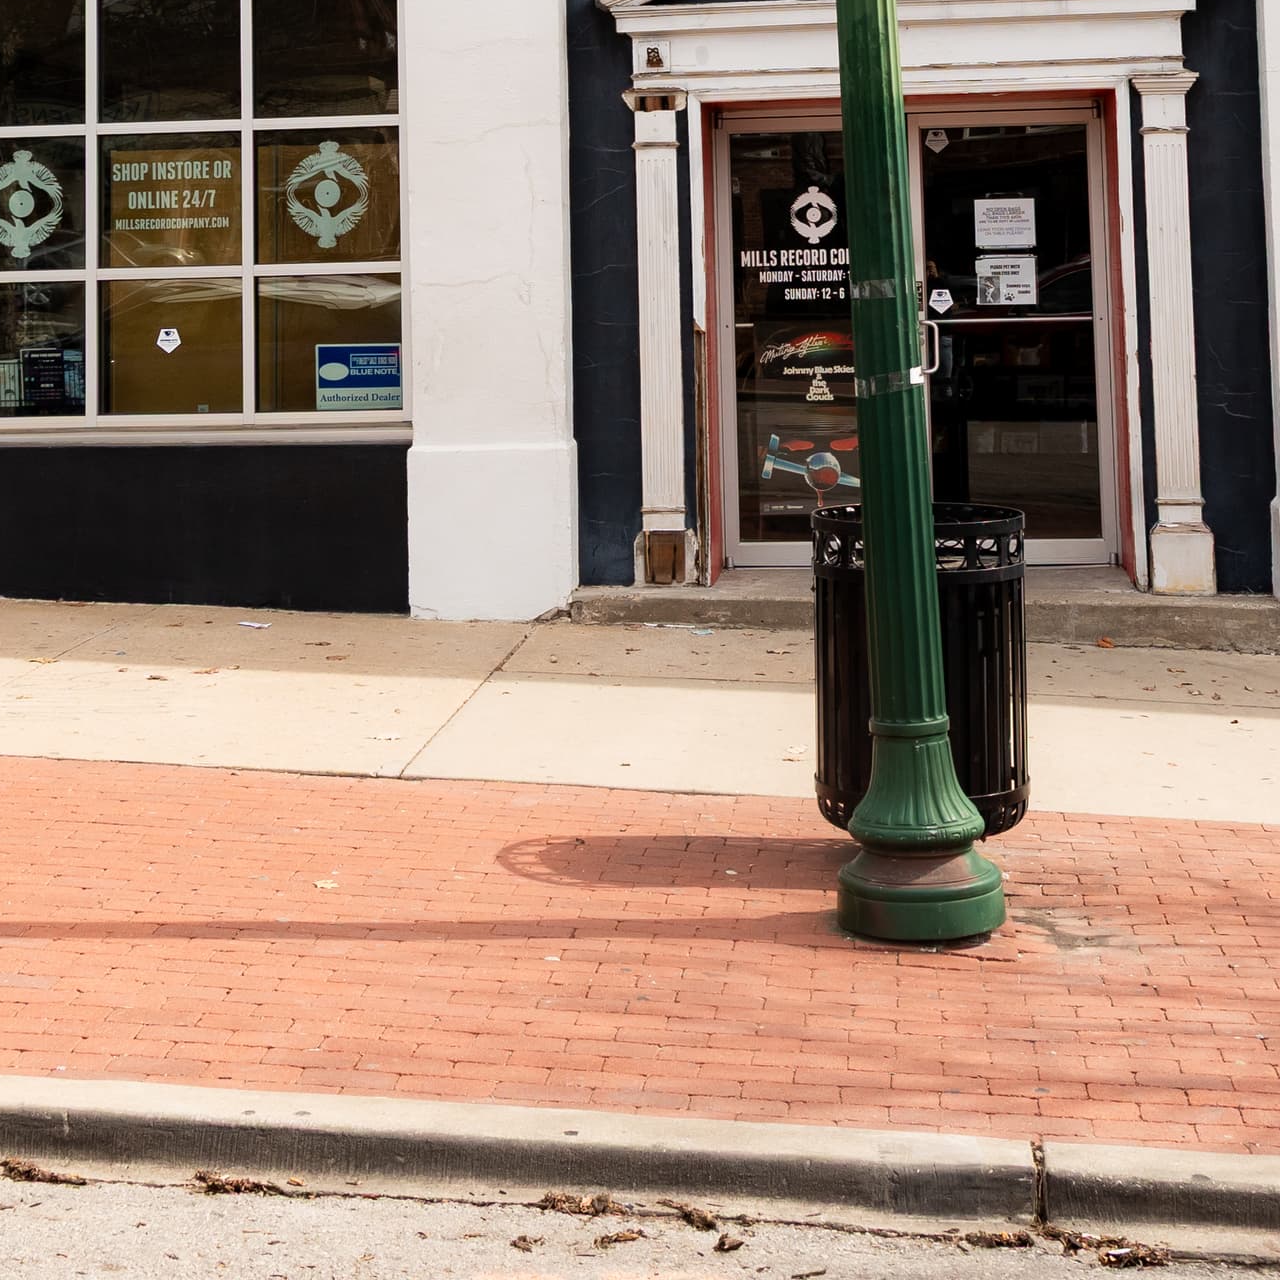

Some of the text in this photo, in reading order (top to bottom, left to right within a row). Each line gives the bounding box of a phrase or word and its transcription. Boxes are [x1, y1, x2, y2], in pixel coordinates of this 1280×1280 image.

[112, 160, 232, 181] SHOP INSTORE OR
[128, 189, 216, 209] ONLINE 24/7
[115, 217, 230, 230] MILLSRECORDCOMPANY.COM
[740, 248, 850, 267] MILLS RECORD CO
[760, 271, 794, 283] MONDAY
[801, 269, 846, 282] SATURDAY:
[784, 288, 820, 300] SUNDAY:
[821, 287, 831, 299] 12
[839, 287, 845, 299] 6
[783, 365, 855, 376] Johnny Blue Skies
[809, 386, 830, 394] Dark
[812, 380, 827, 388] the
[320, 393, 401, 402] Authorized Dealer
[806, 393, 834, 401] Clouds
